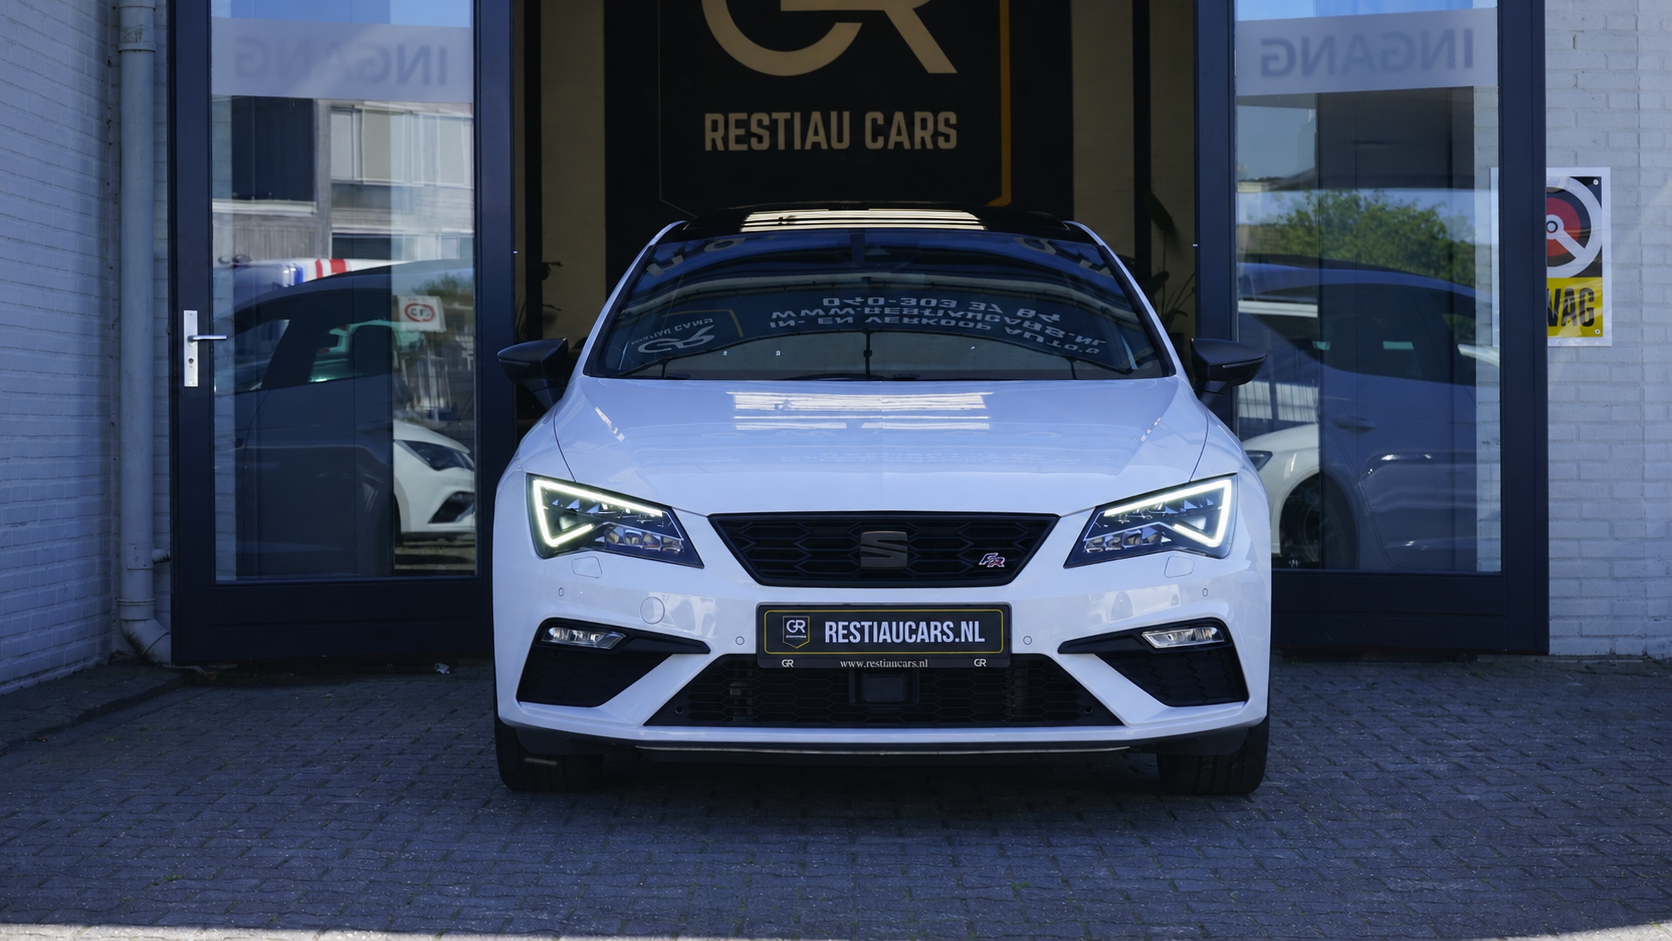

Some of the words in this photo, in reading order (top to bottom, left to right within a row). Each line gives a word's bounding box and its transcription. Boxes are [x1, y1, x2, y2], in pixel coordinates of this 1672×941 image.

[704, 111, 850, 151] RESTIAU
[865, 111, 957, 150] CARS
[1547, 287, 1595, 328] VAG
[978, 552, 1006, 568] FR
[785, 619, 806, 634] GR
[824, 620, 986, 644] RESTIAUCARS.NL
[781, 658, 795, 668] GR
[840, 658, 929, 669] www.restiaucars.nl
[973, 658, 987, 667] GR
